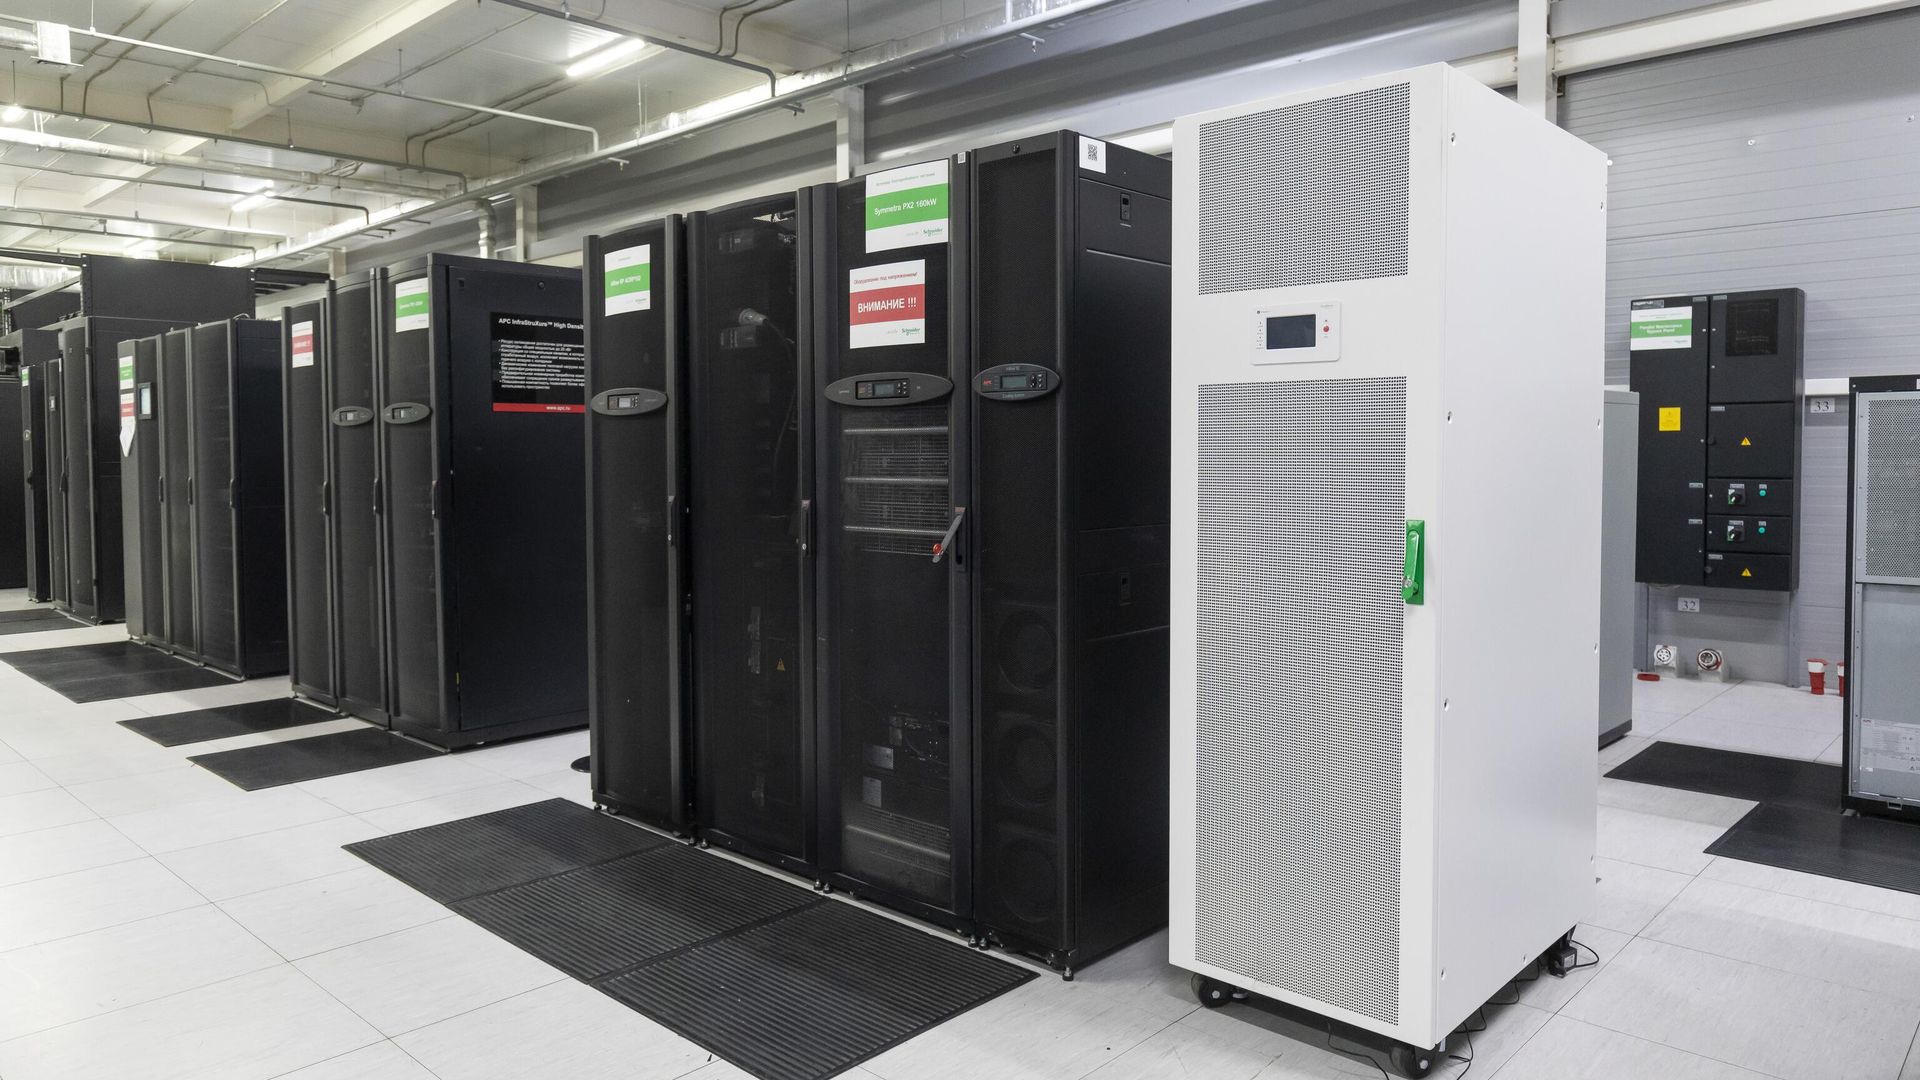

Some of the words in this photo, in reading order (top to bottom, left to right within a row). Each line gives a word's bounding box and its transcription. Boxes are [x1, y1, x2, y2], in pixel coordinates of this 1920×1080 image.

[874, 204, 902, 216] Symmetra
[902, 201, 914, 210] PX2
[858, 298, 905, 313] ВНИМАНИЕ
[907, 296, 917, 308] !!!
[1814, 400, 1830, 412] 33
[1682, 601, 1696, 611] 32
